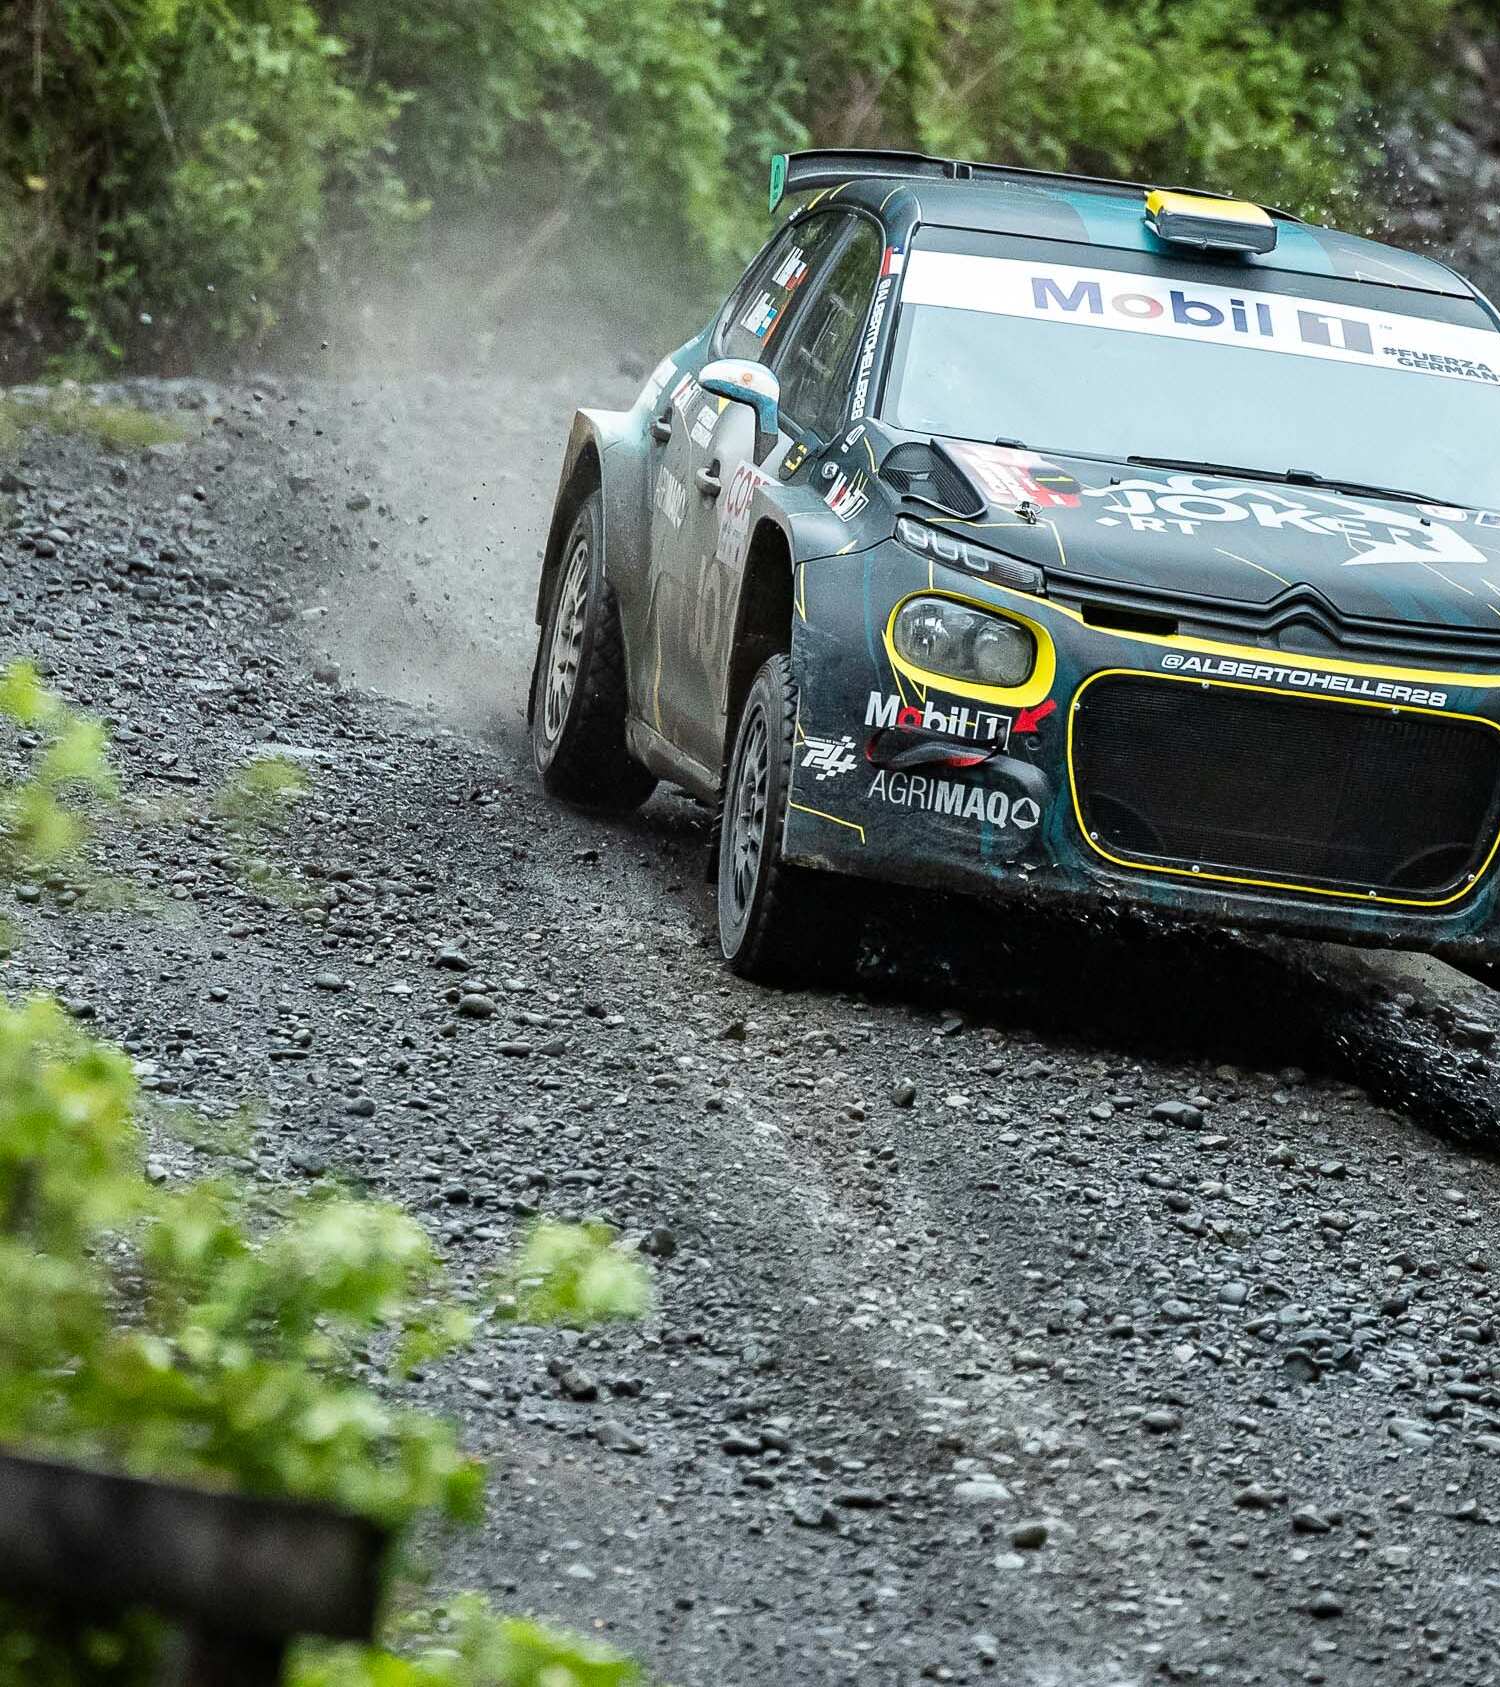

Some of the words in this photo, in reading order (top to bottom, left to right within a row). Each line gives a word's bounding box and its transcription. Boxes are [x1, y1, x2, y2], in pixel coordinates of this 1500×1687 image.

[1031, 277, 1273, 337] Mobil
[1382, 346, 1493, 372] #FUERZA
[1161, 653, 1448, 708] @ALBERTOHELLER28
[864, 691, 970, 738] Mobil
[867, 768, 1009, 828] AGRIMAQ
